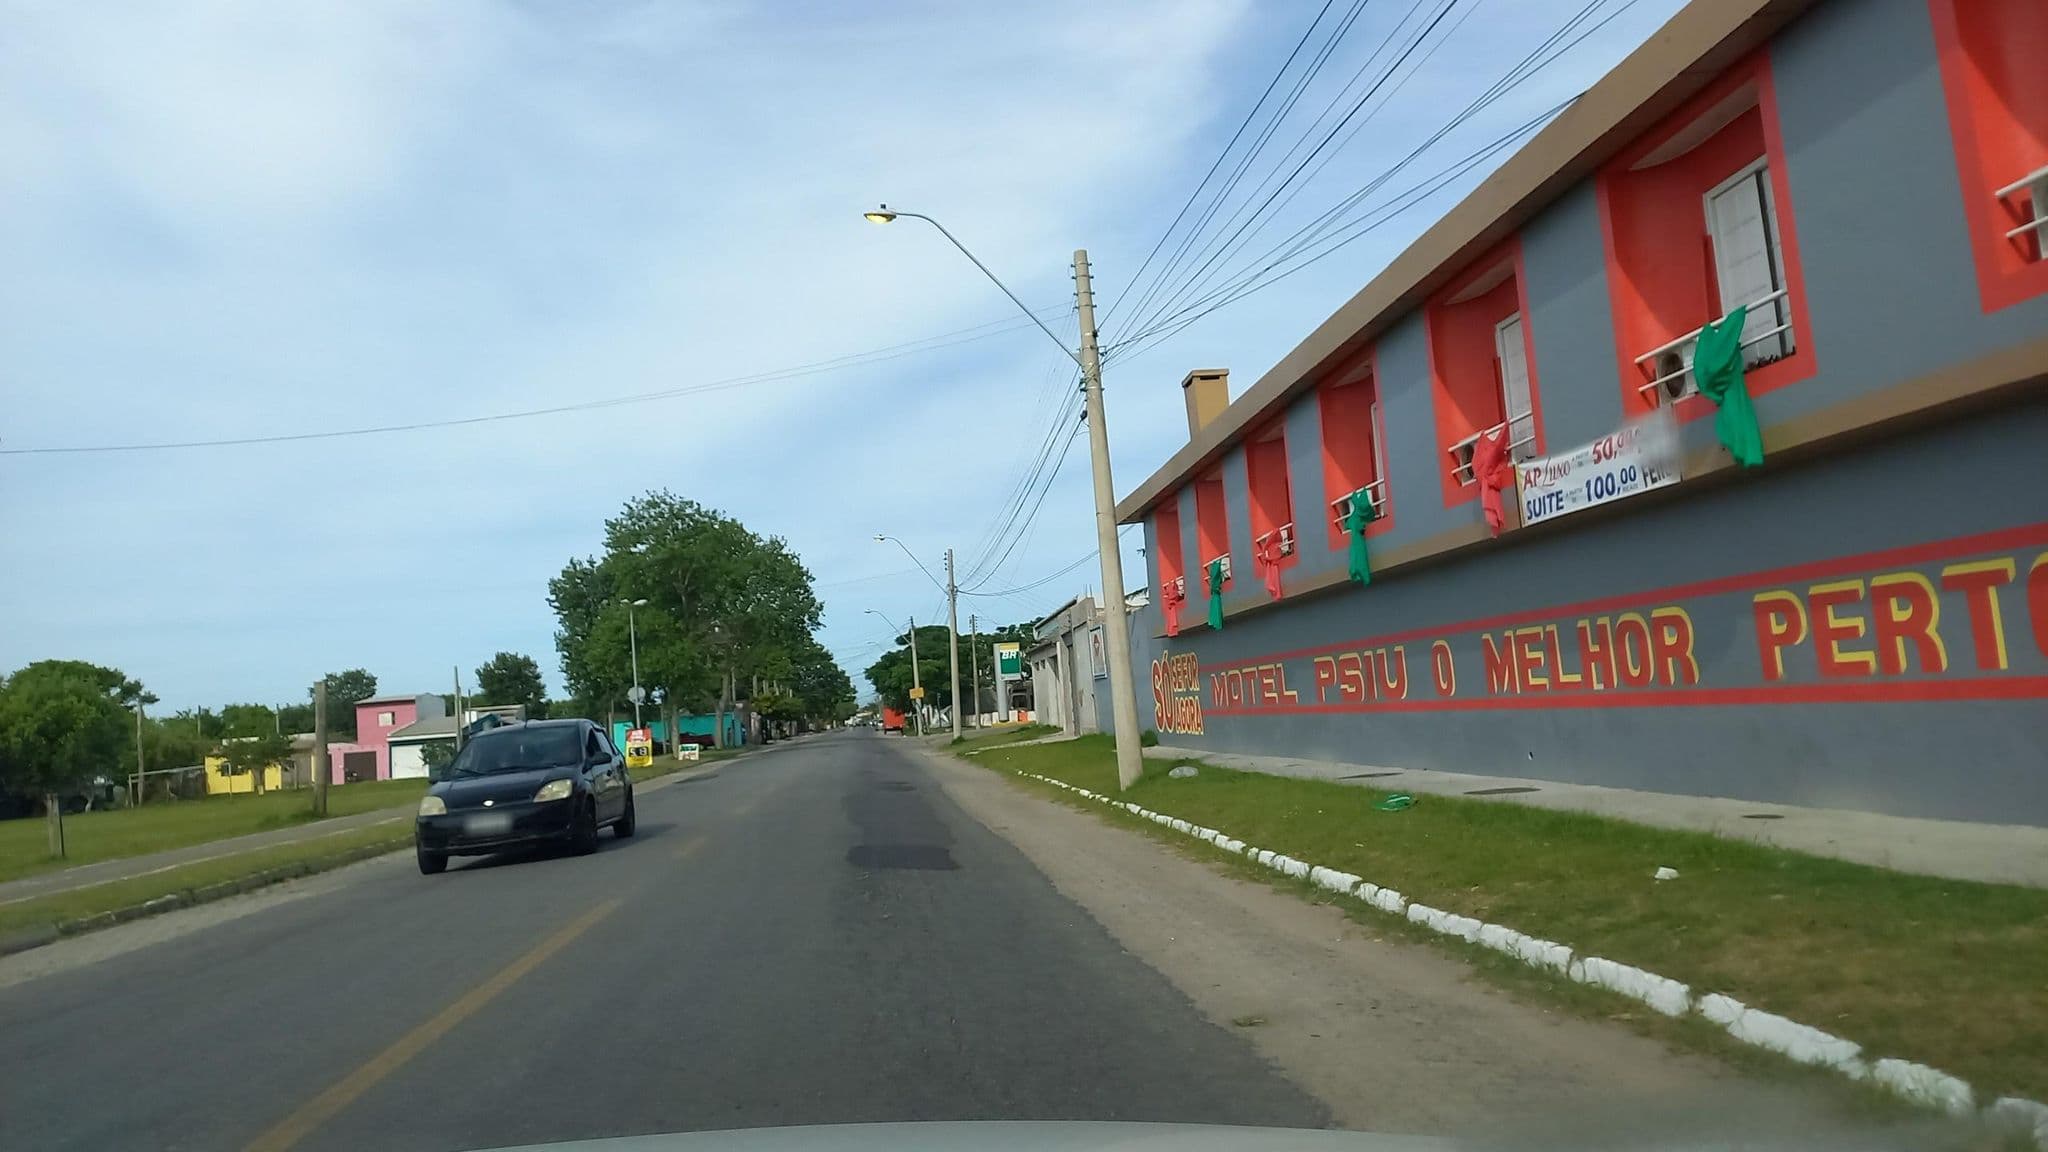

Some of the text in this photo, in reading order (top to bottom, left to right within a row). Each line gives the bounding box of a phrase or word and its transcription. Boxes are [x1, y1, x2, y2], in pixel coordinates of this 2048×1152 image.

[1523, 469, 1542, 491] AP
[1527, 489, 1565, 520] SUITE
[1585, 465, 1637, 502] 100,00
[1002, 651, 1017, 659] BR
[1210, 662, 1299, 708] MOTEL
[1313, 644, 1410, 703] PSIU
[1481, 605, 1700, 695] MELHOR
[1174, 695, 1204, 735] AGORA
